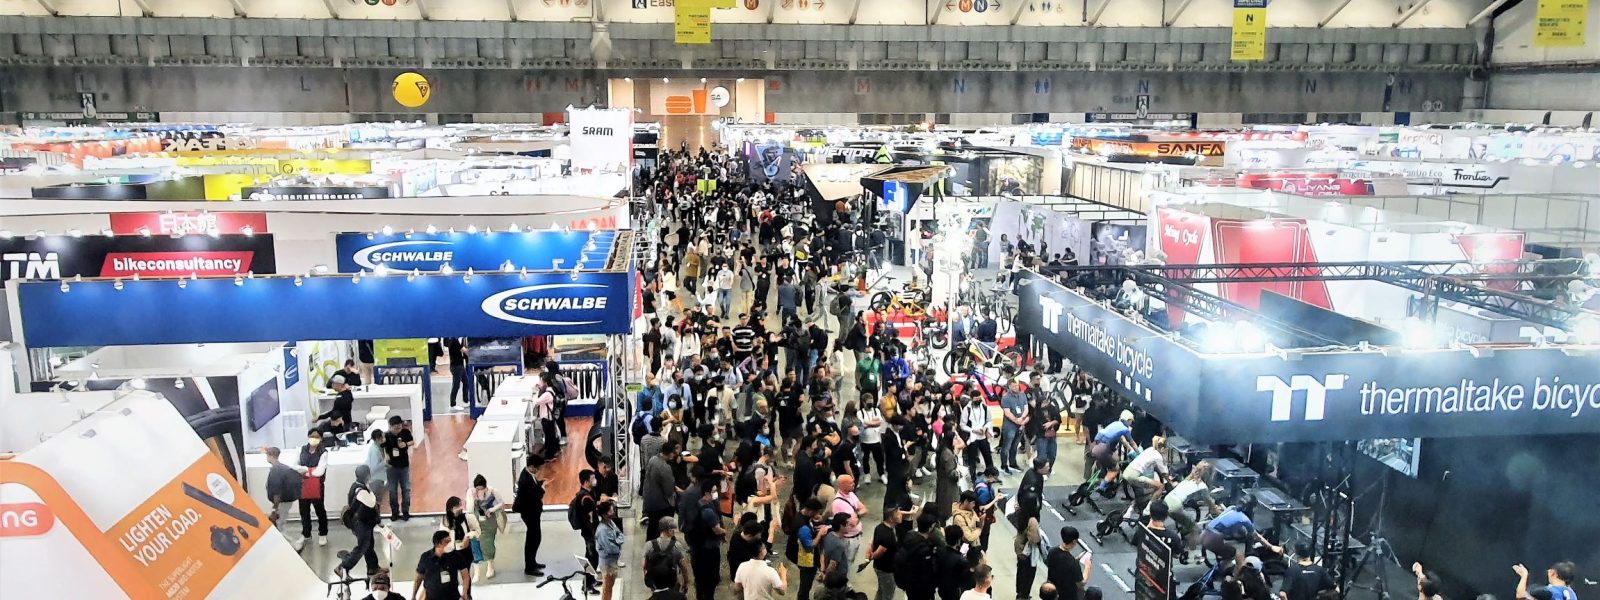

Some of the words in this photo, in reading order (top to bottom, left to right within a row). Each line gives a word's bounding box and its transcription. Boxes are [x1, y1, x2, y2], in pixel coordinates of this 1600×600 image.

[1246, 14, 1254, 22] N
[953, 78, 965, 93] N
[1138, 79, 1149, 93] N
[1306, 79, 1317, 93] N
[582, 126, 613, 136] SRAM
[815, 147, 875, 158] MERIDA
[1157, 143, 1223, 155] SANFA
[1453, 169, 1493, 182] Frontier
[1298, 184, 1341, 192] LIYANG
[371, 251, 453, 262] SCHWALBE
[0, 253, 60, 279] TM
[114, 257, 242, 272] bikeconsultancy
[505, 296, 607, 311] SCHWALBE
[1067, 311, 1115, 358] thermaltake
[1116, 335, 1154, 379] bicycle
[1360, 377, 1524, 417] thermaltake
[119, 503, 172, 552] LIGHTEN
[133, 532, 173, 567] YOUR
[165, 508, 202, 541] LOAD.
